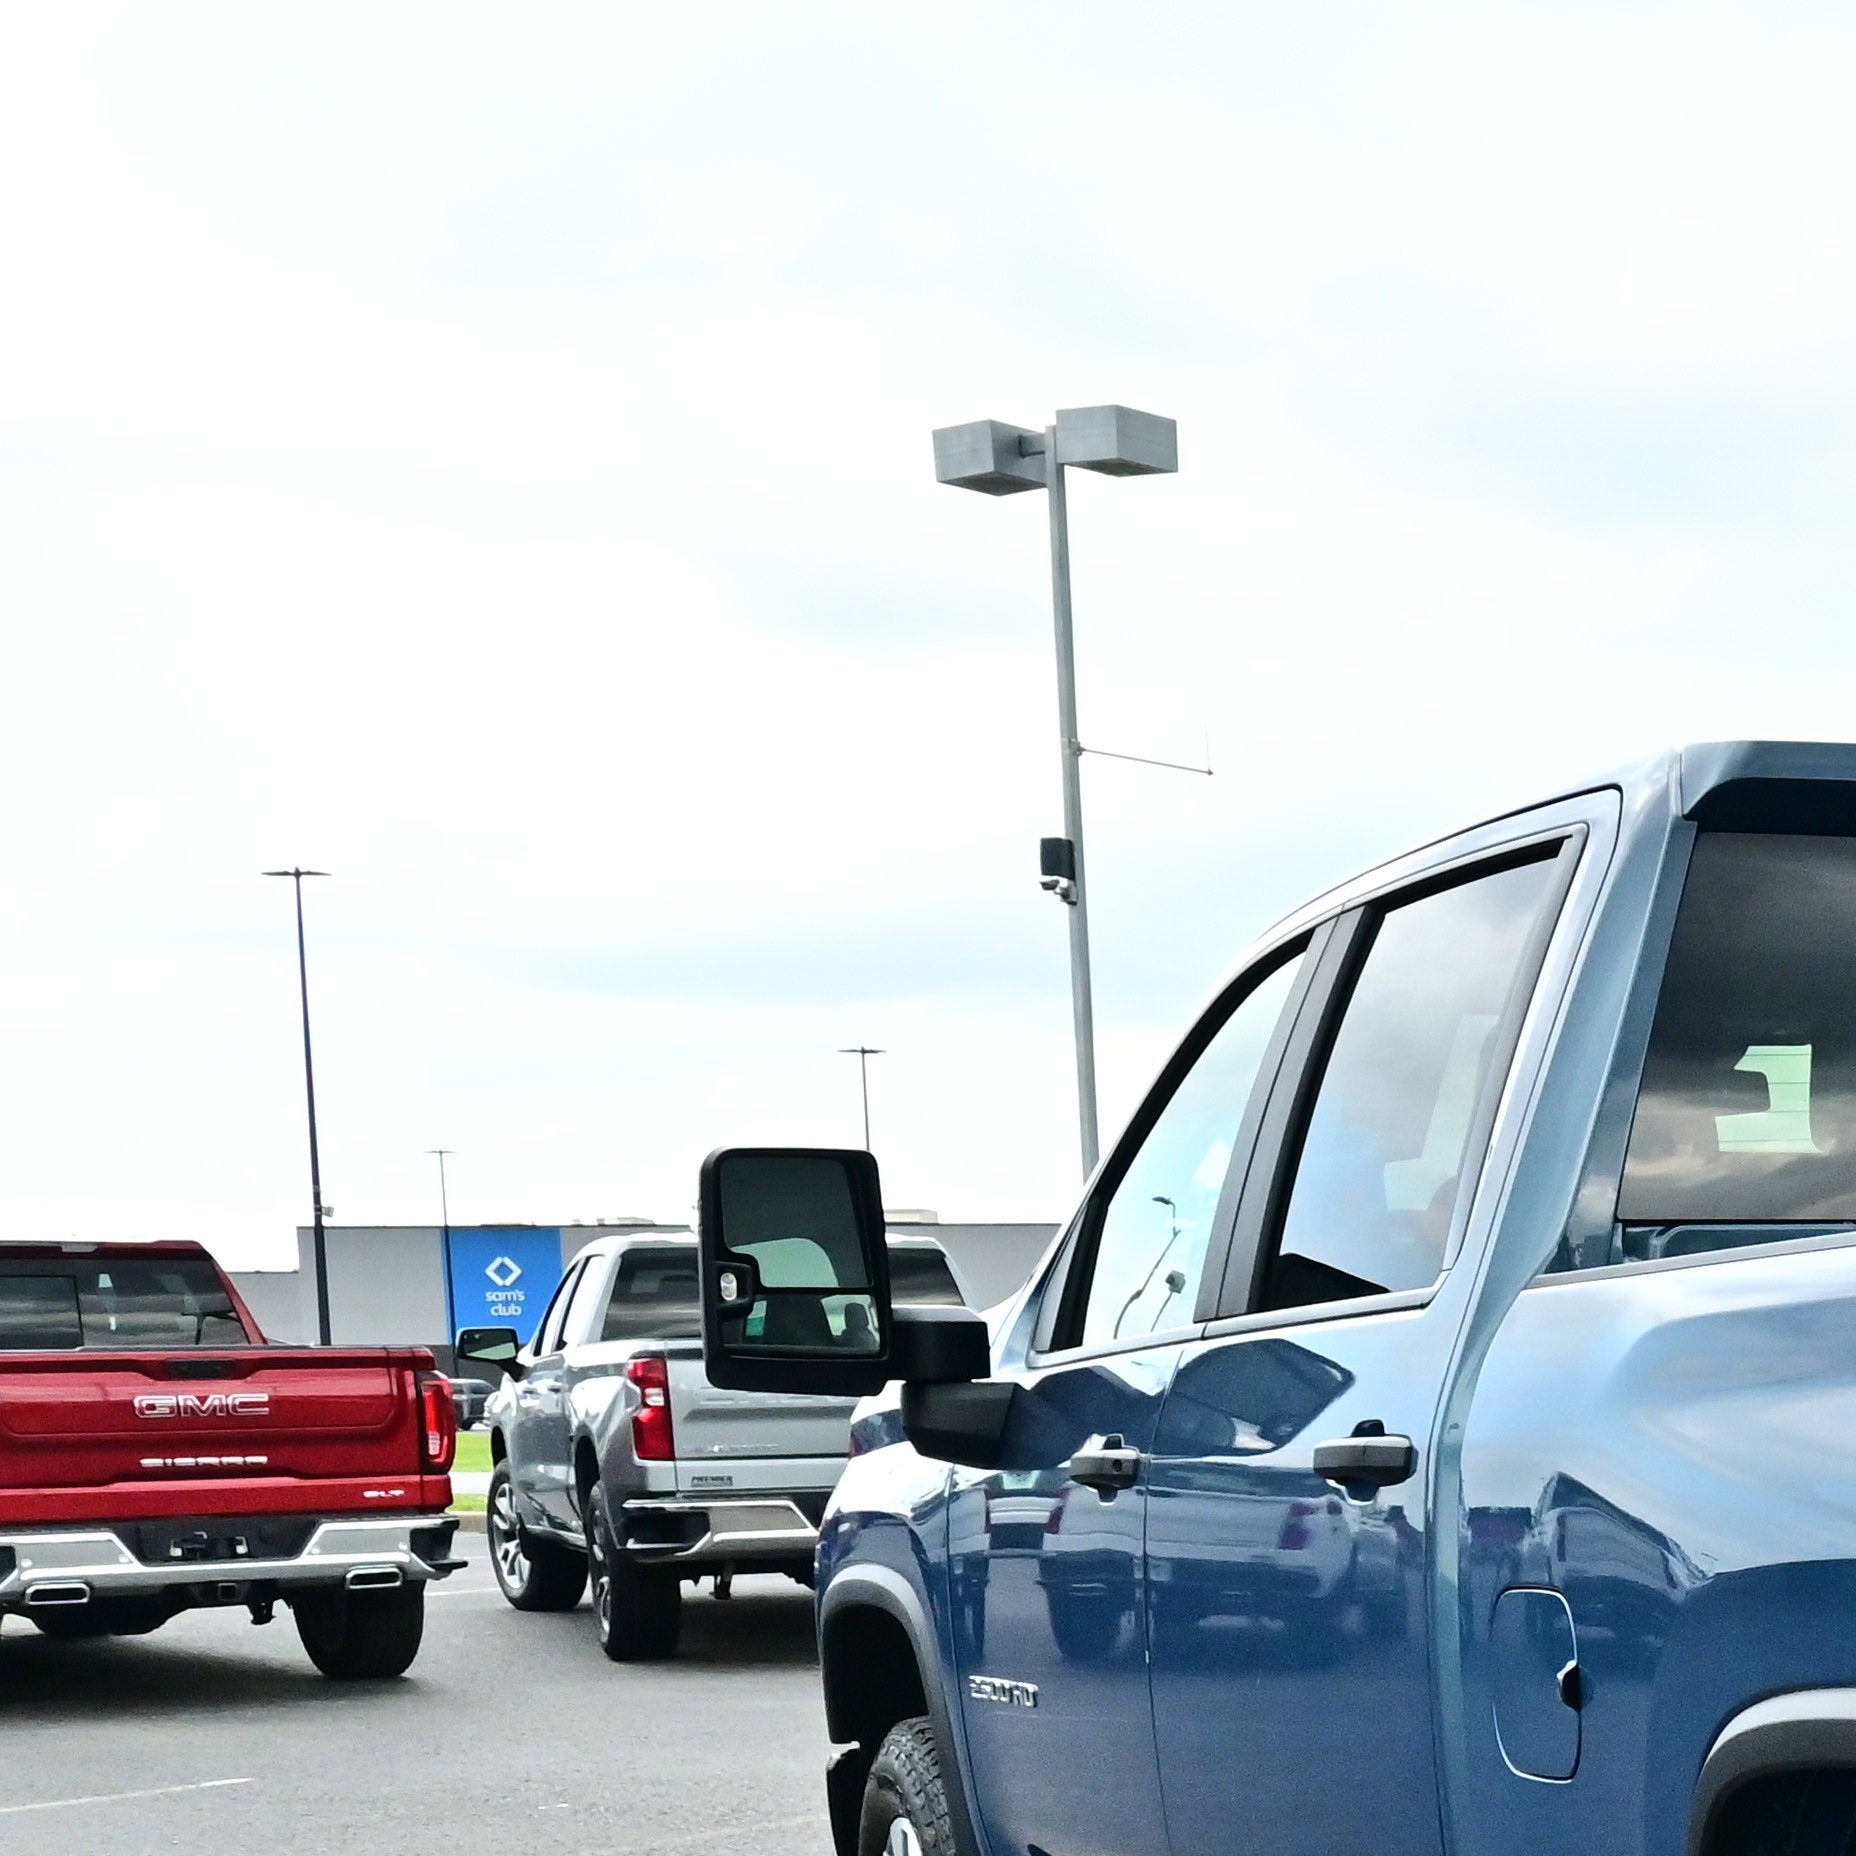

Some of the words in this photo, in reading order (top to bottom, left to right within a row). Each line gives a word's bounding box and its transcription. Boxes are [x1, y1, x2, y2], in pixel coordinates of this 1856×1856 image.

[485, 1289, 526, 1302] sam's
[490, 1303, 522, 1316] club
[133, 1393, 270, 1418] GMC
